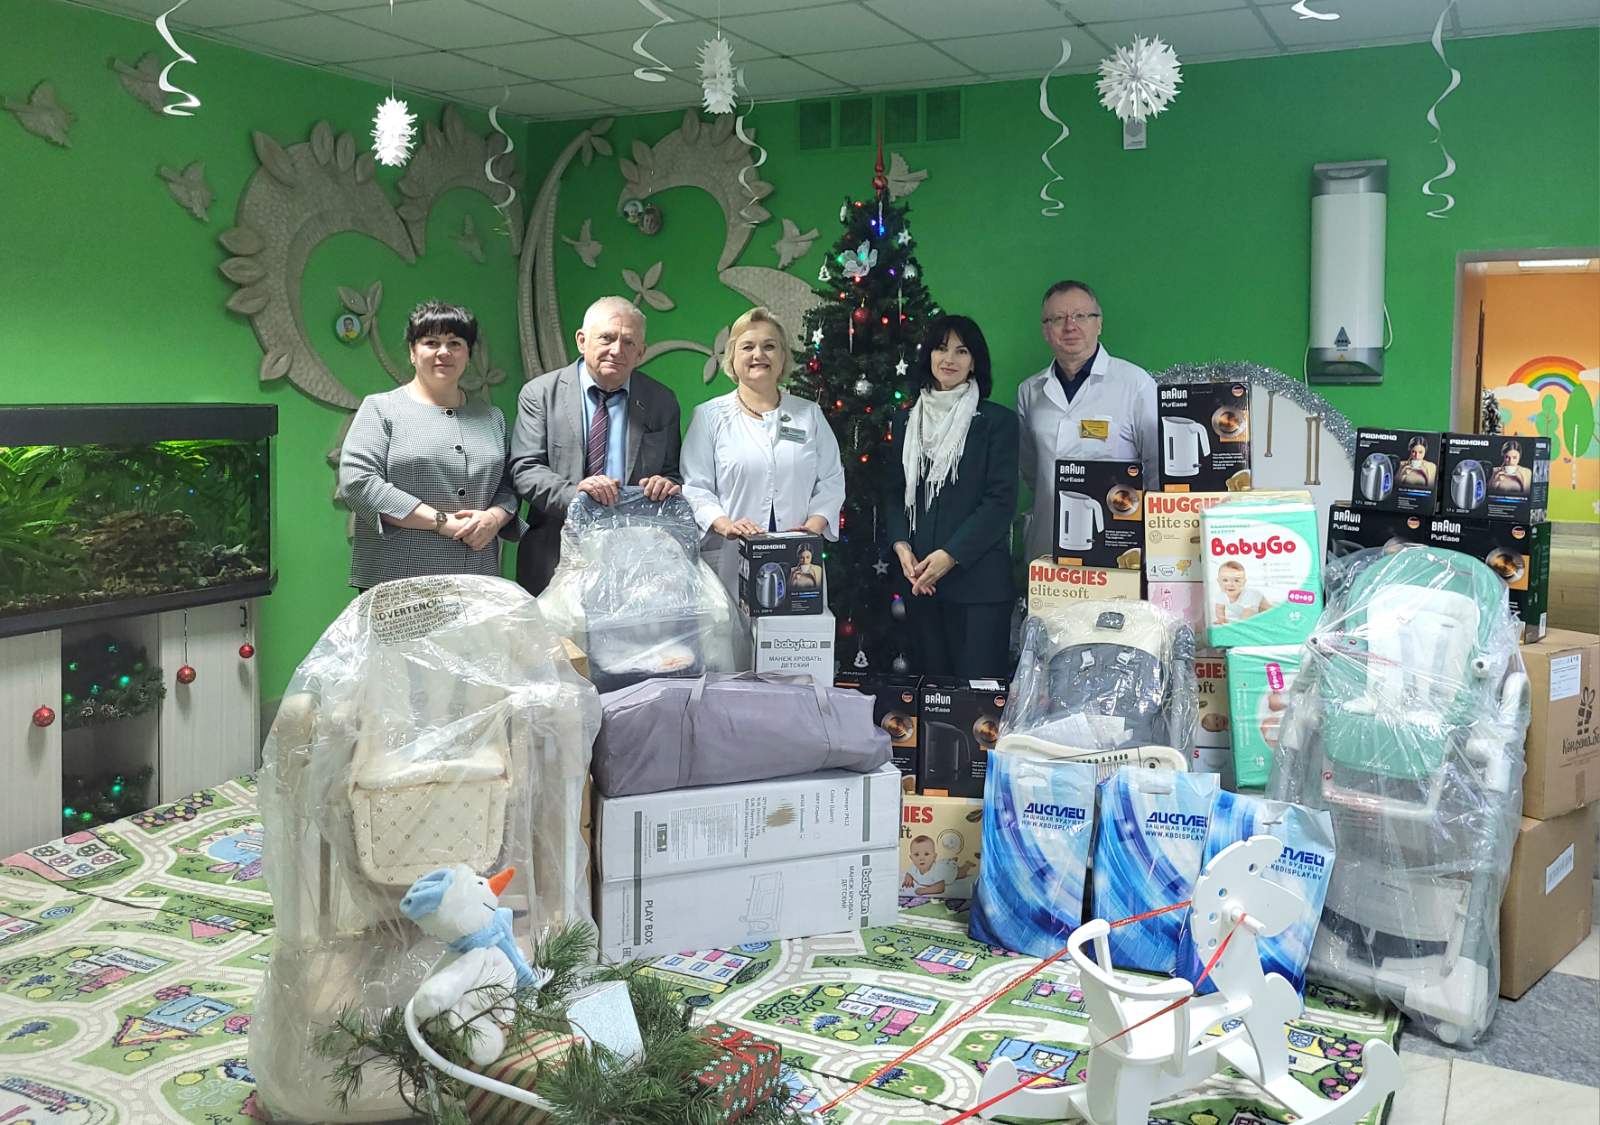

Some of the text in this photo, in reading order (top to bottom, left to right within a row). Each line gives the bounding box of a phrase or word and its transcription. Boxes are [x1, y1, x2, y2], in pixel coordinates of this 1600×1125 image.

[1148, 516, 1181, 529] elite
[1184, 517, 1200, 529] so
[1333, 523, 1360, 532] PurEase
[1431, 534, 1460, 543] PurEase
[1211, 535, 1297, 559] BabyGo
[1031, 565, 1107, 586] HUGGIES
[1031, 584, 1090, 599] elite soft
[644, 900, 654, 944] PLAY BOX
